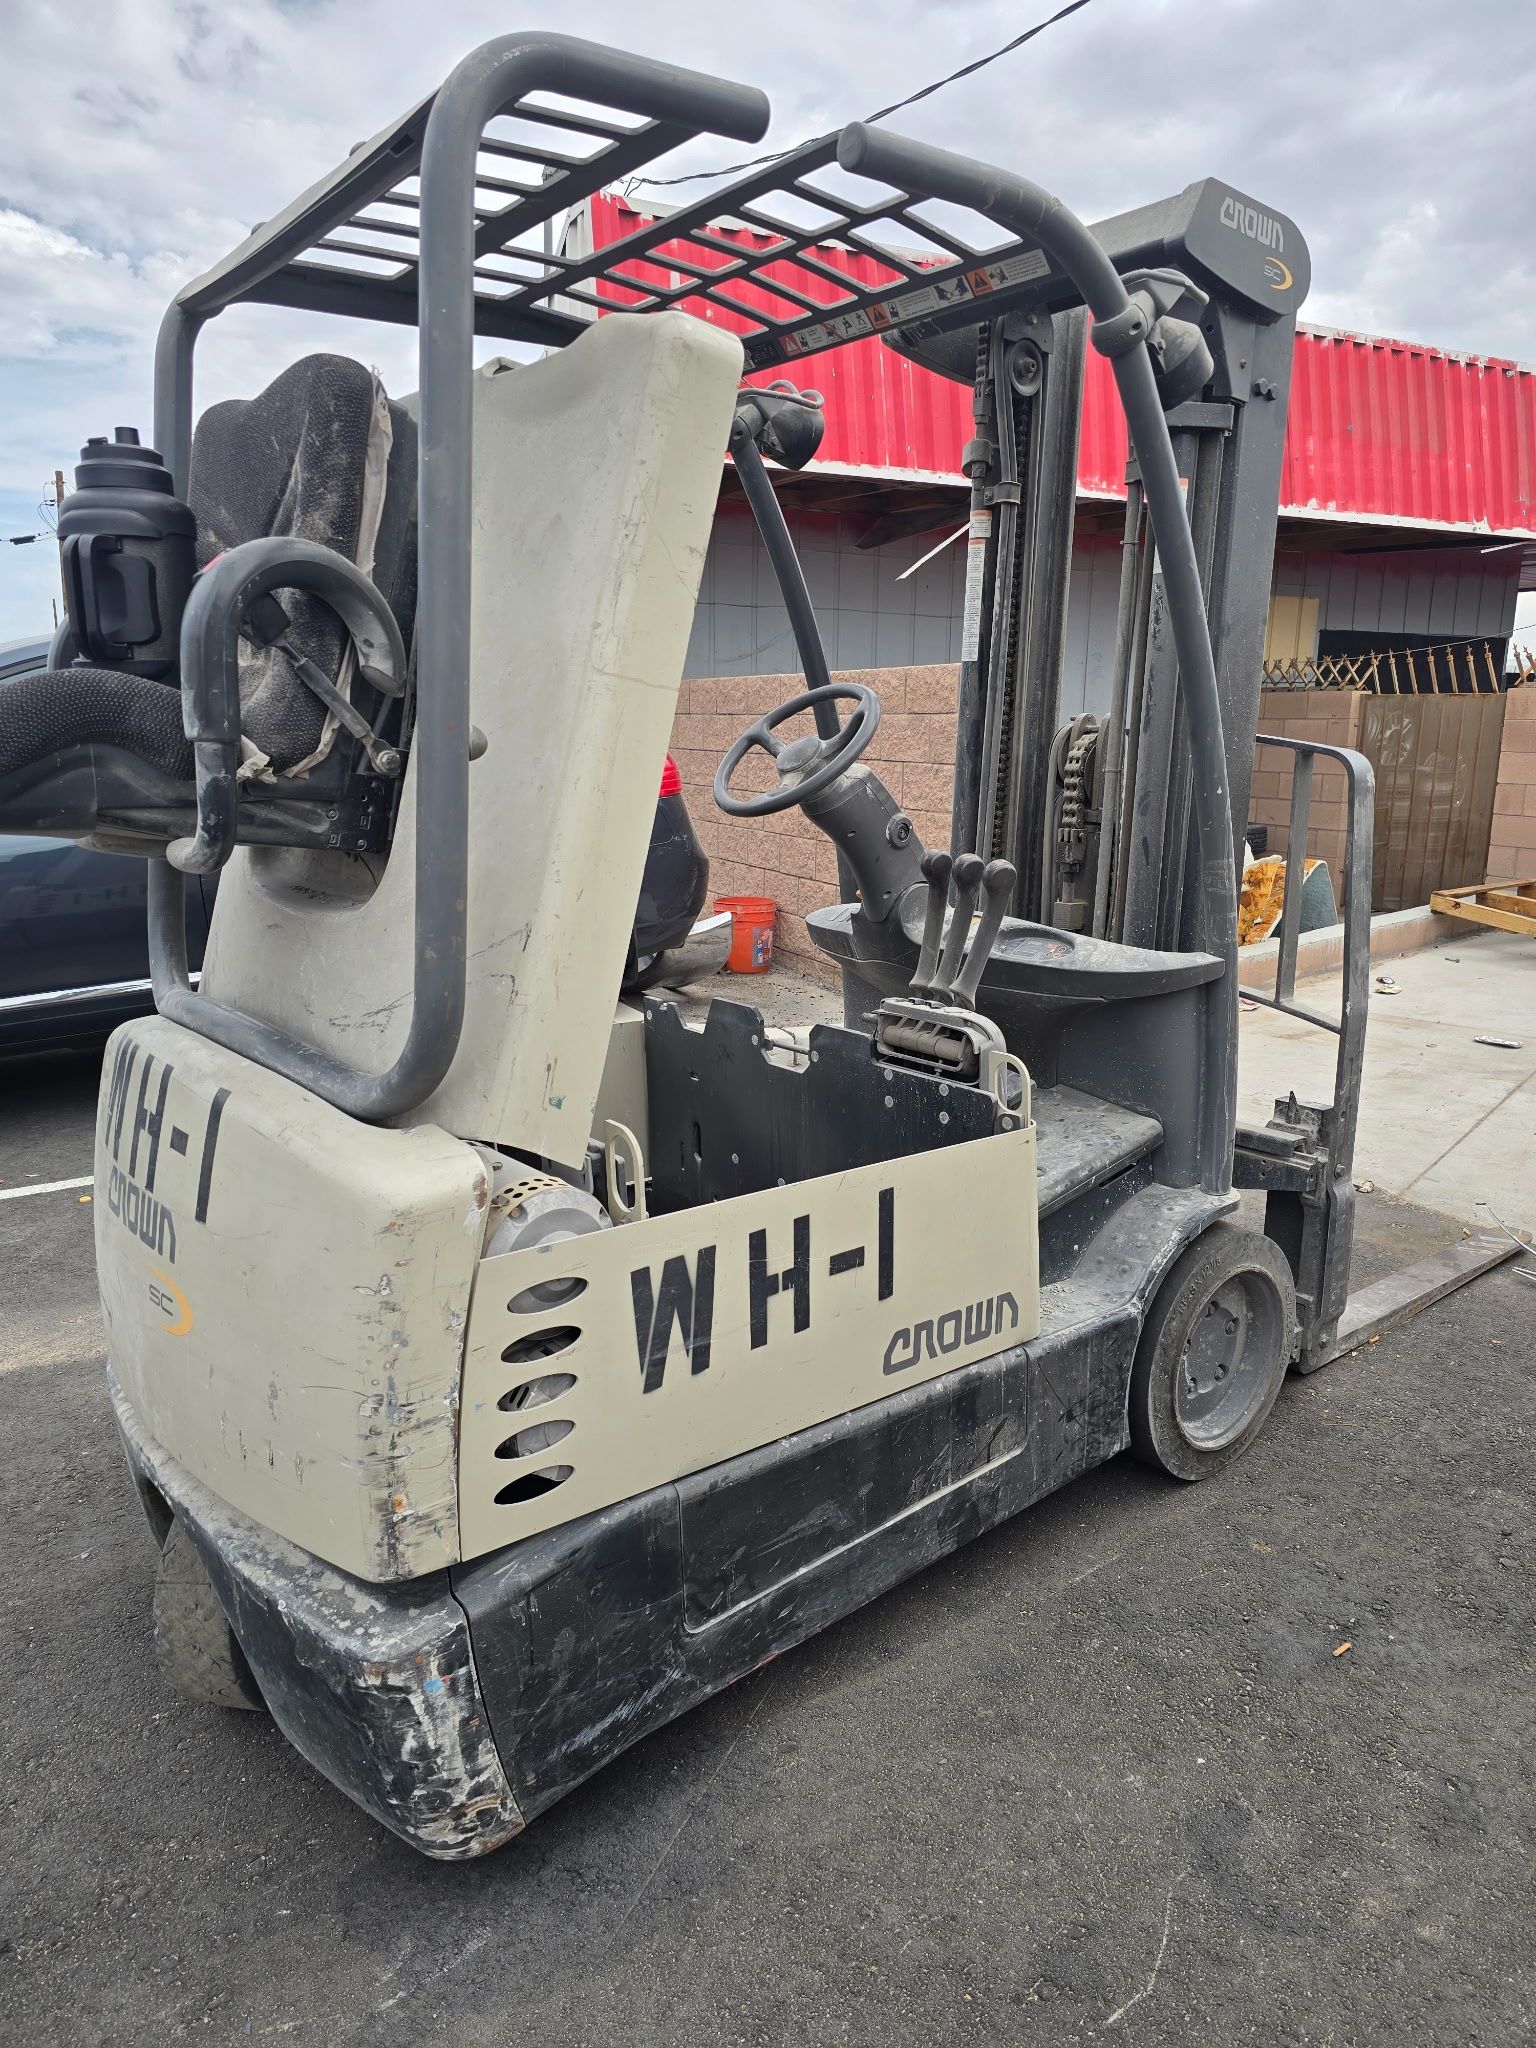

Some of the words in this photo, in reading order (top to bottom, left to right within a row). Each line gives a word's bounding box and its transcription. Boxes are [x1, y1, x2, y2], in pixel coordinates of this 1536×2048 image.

[1219, 196, 1284, 253] CROWN
[1263, 265, 1281, 281] SC
[107, 1163, 177, 1265] CROWN
[148, 1283, 174, 1317] SC
[882, 1290, 1020, 1377] CROWN
